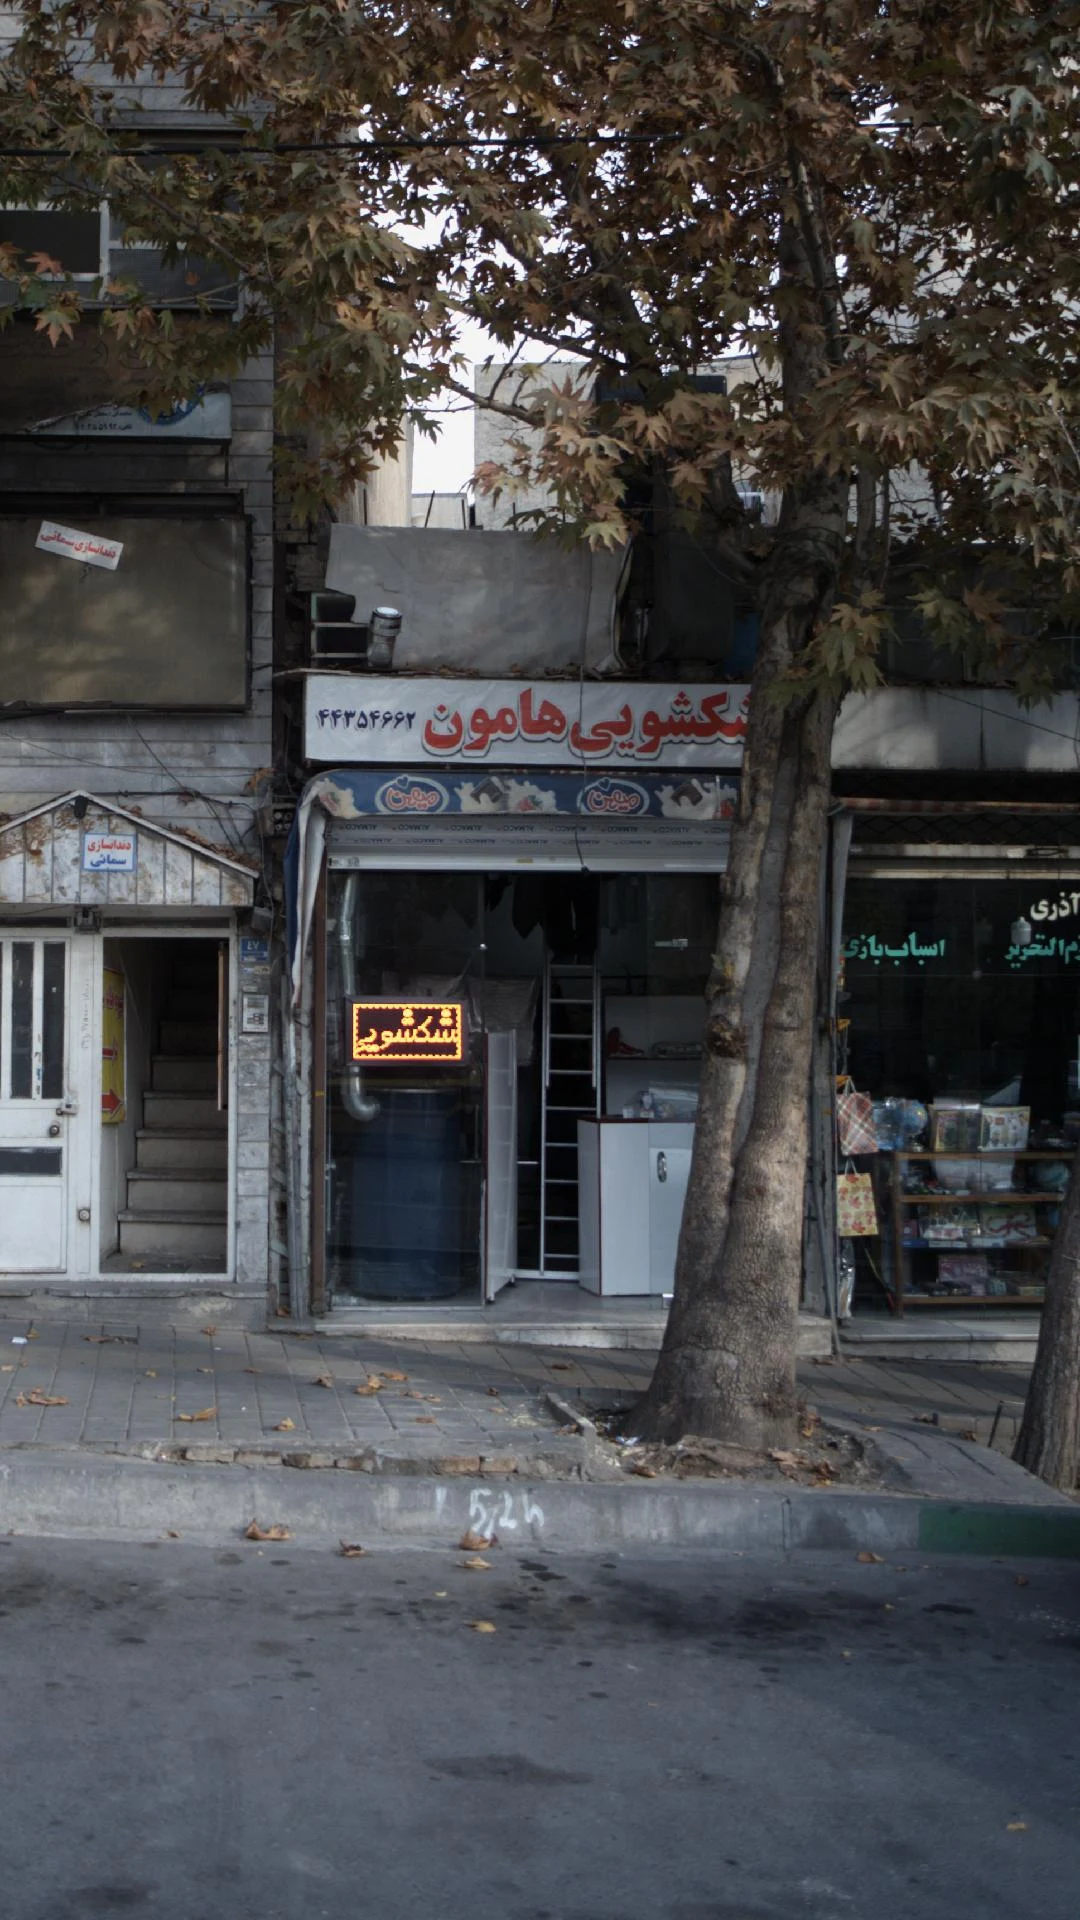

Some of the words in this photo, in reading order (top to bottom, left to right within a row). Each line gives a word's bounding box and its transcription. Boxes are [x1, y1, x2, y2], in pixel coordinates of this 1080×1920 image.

[318, 709, 416, 729] ۴۴۳۵۴۶۶۲
[424, 687, 567, 750] هامون
[842, 934, 883, 965] بازی
[885, 931, 946, 965] اسباب
